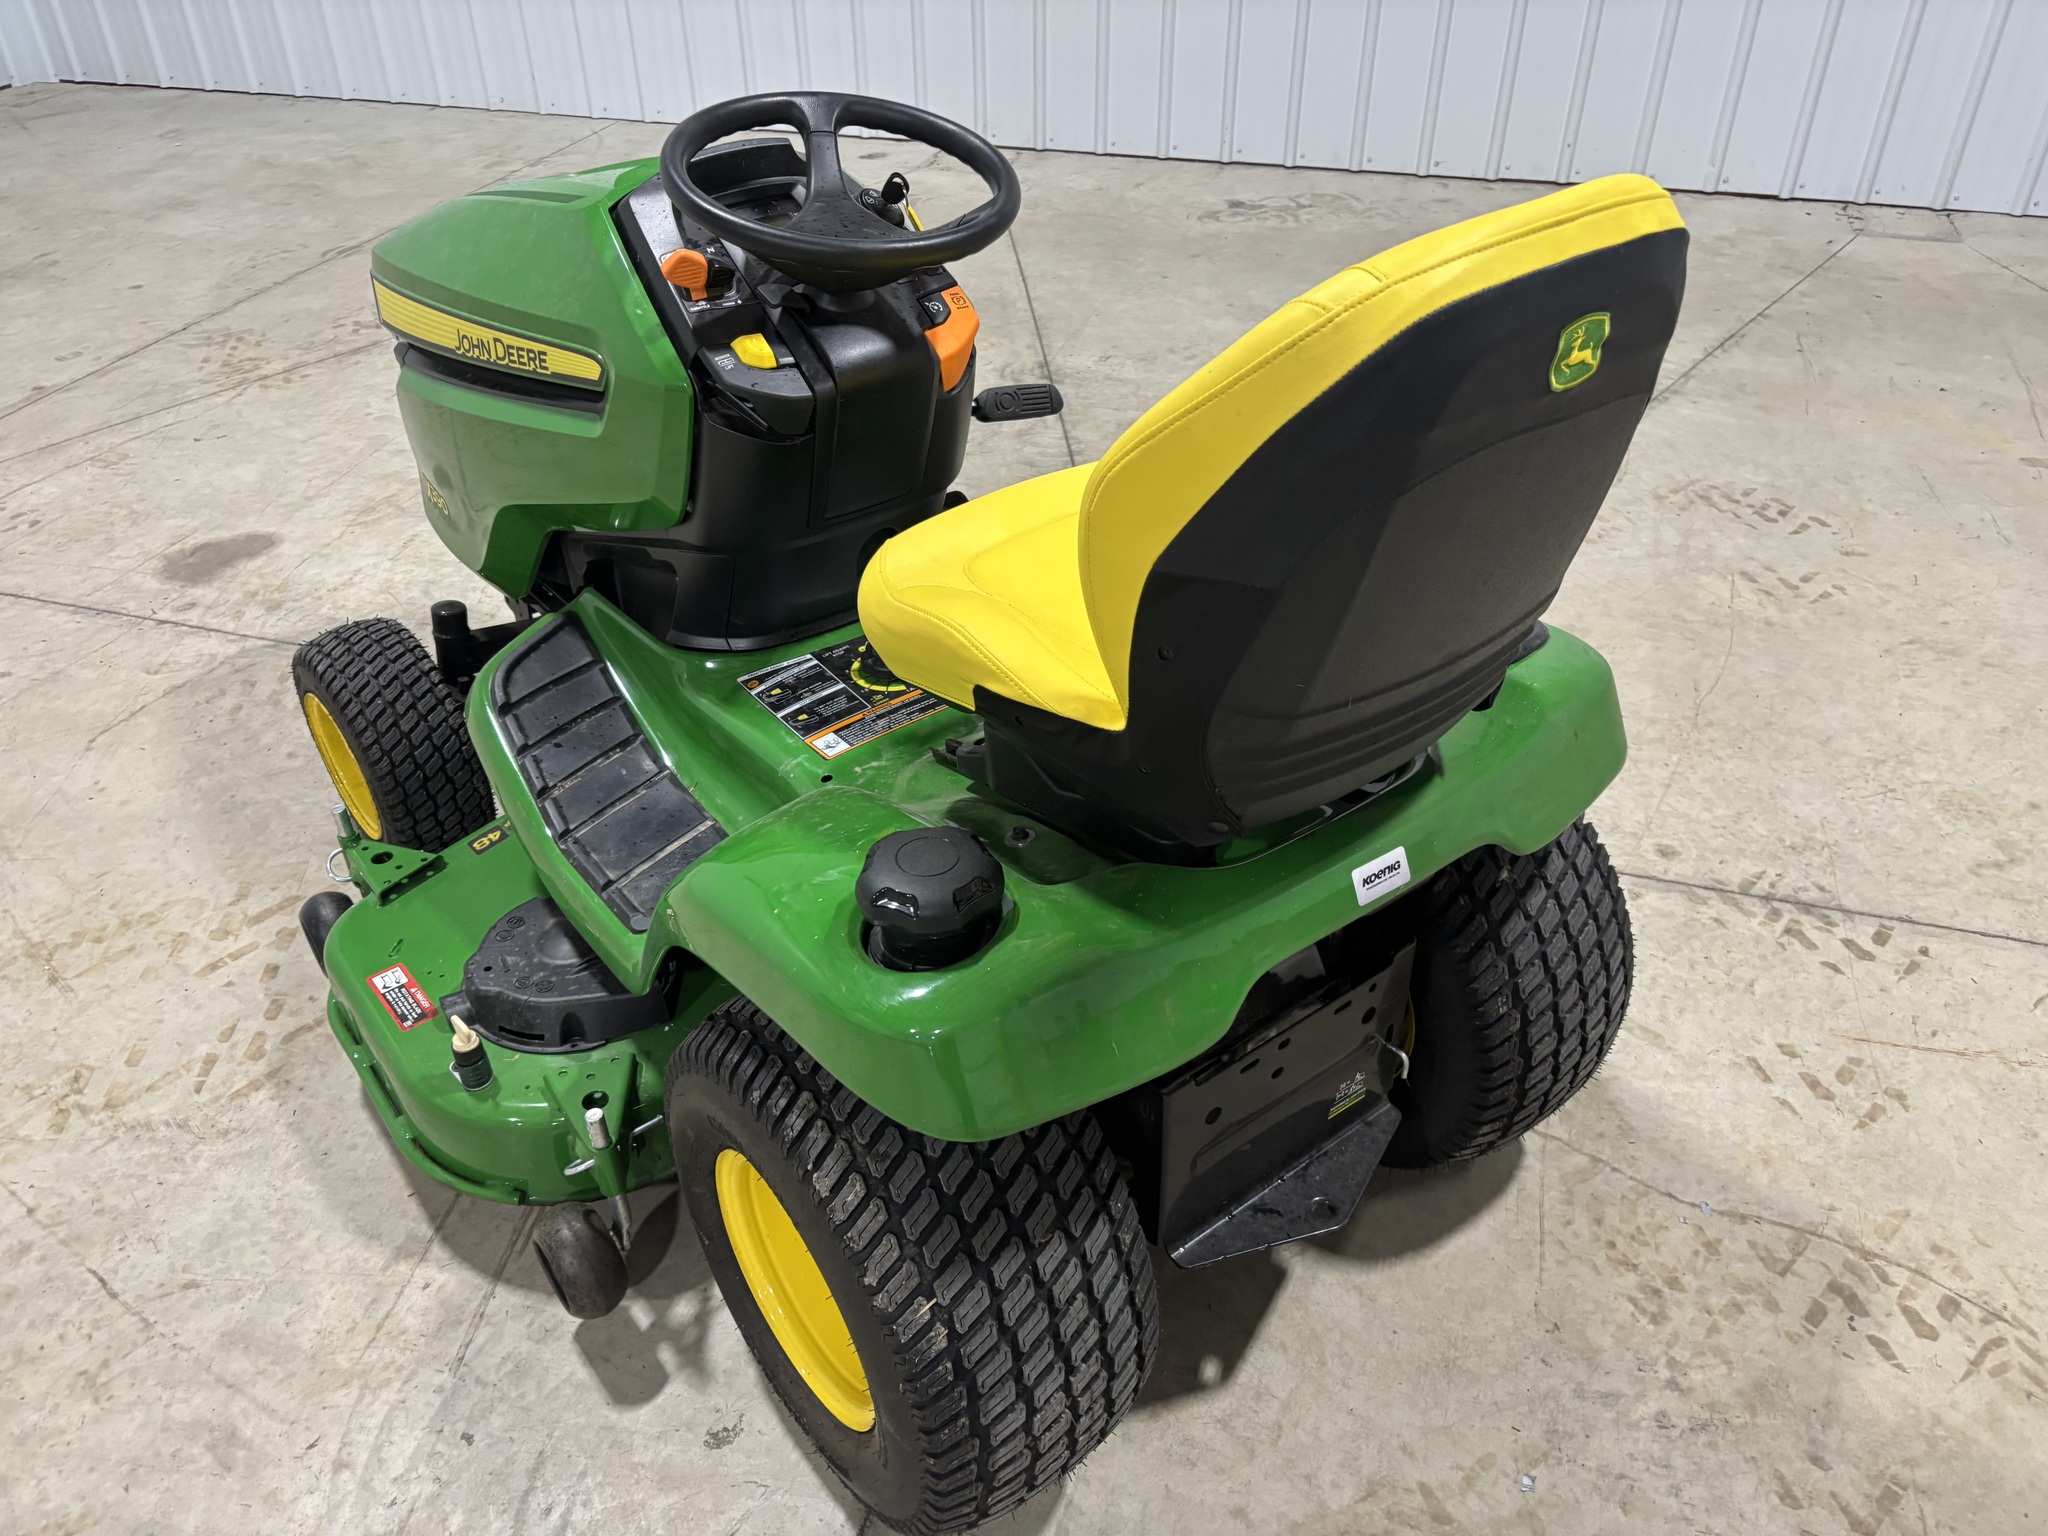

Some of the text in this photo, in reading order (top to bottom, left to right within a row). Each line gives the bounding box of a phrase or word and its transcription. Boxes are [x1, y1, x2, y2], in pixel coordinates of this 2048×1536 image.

[455, 328, 551, 373] JOHN DEERE
[472, 830, 502, 850] 48
[414, 990, 430, 1008] DANGER
